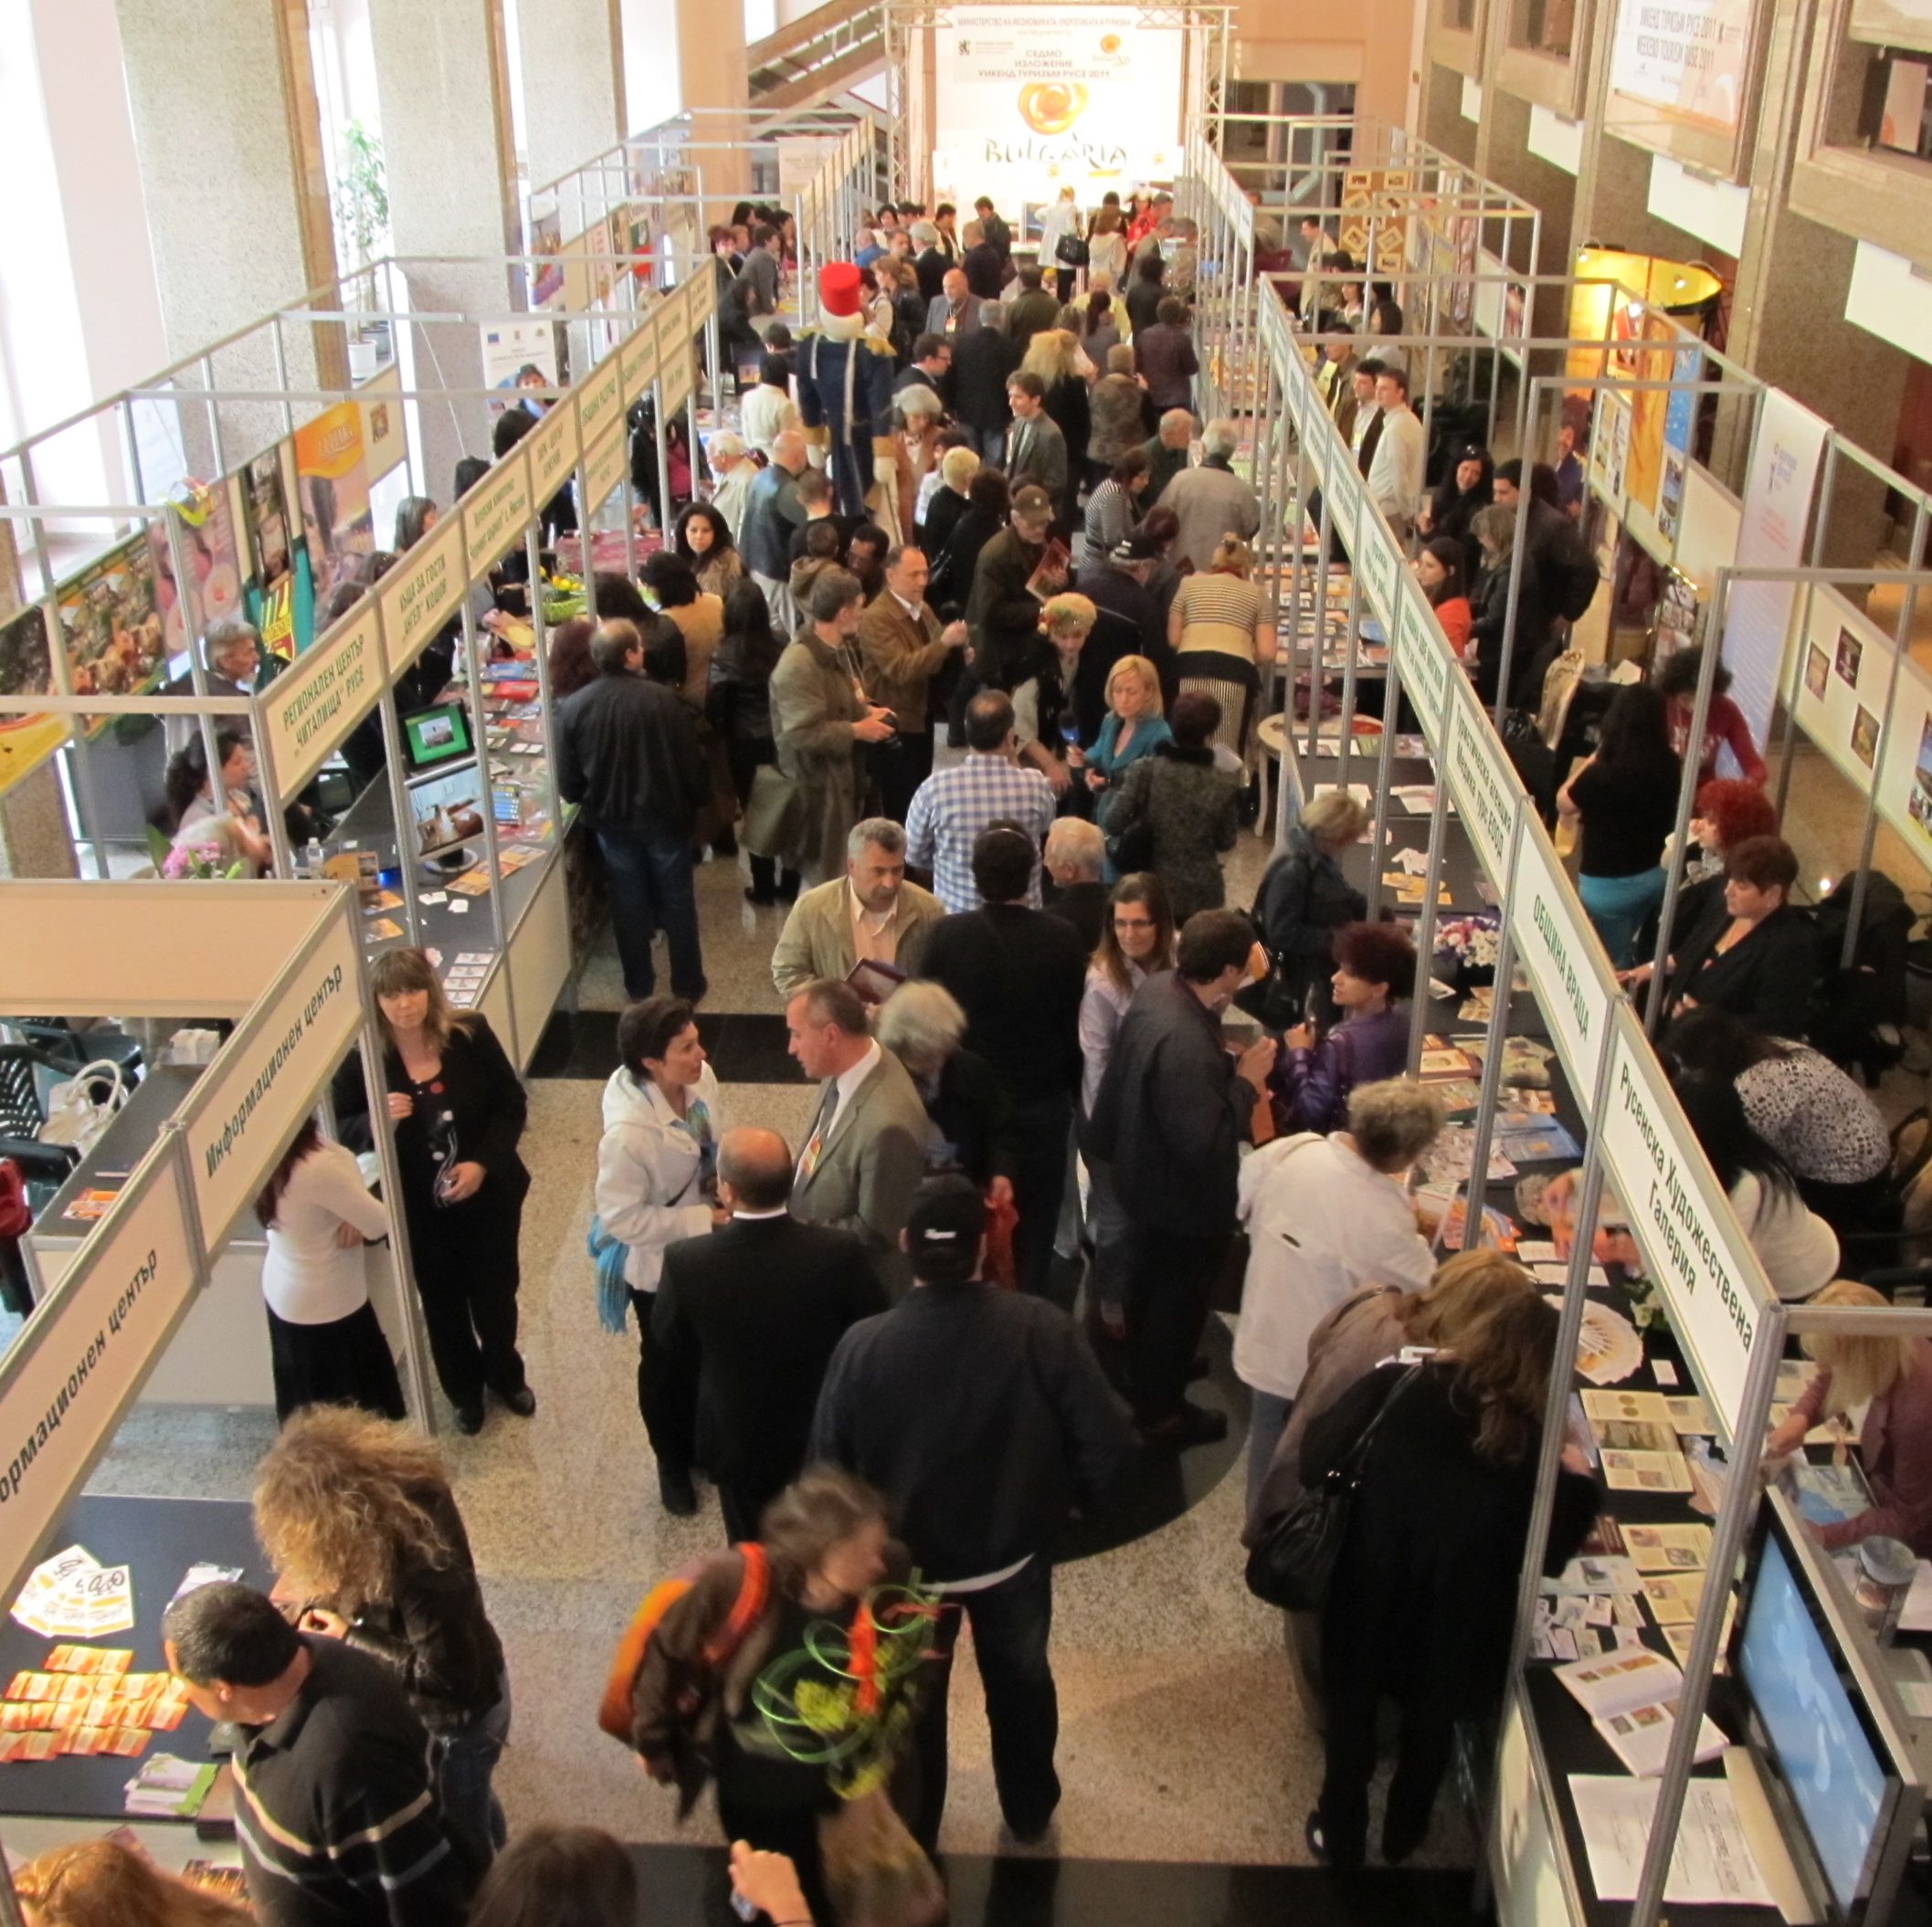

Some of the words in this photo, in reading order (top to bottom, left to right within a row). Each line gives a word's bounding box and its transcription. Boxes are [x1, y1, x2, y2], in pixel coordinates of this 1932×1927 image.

[1014, 59, 1073, 68] ИЗЛОЖЕНИЕ
[1062, 69, 1086, 78] РУСЕ
[1089, 69, 1110, 78] 2011
[426, 553, 446, 586] ГОСТИ
[282, 669, 336, 731] РЕГИОНАЛЕН
[335, 635, 364, 678] ЦЕНТЪР
[346, 664, 365, 698] РУСЕ
[1488, 809, 1504, 865] ЕООД
[1533, 894, 1567, 981] ОБЩИНА
[1566, 963, 1589, 1042] ВРАЦА
[206, 1016, 303, 1179] Информационен
[304, 963, 343, 1028] център
[1620, 1059, 1665, 1178] Русенска
[1665, 1155, 1754, 1353] Художествена
[1648, 1179, 1697, 1297] Галерия
[109, 1248, 157, 1335] център
